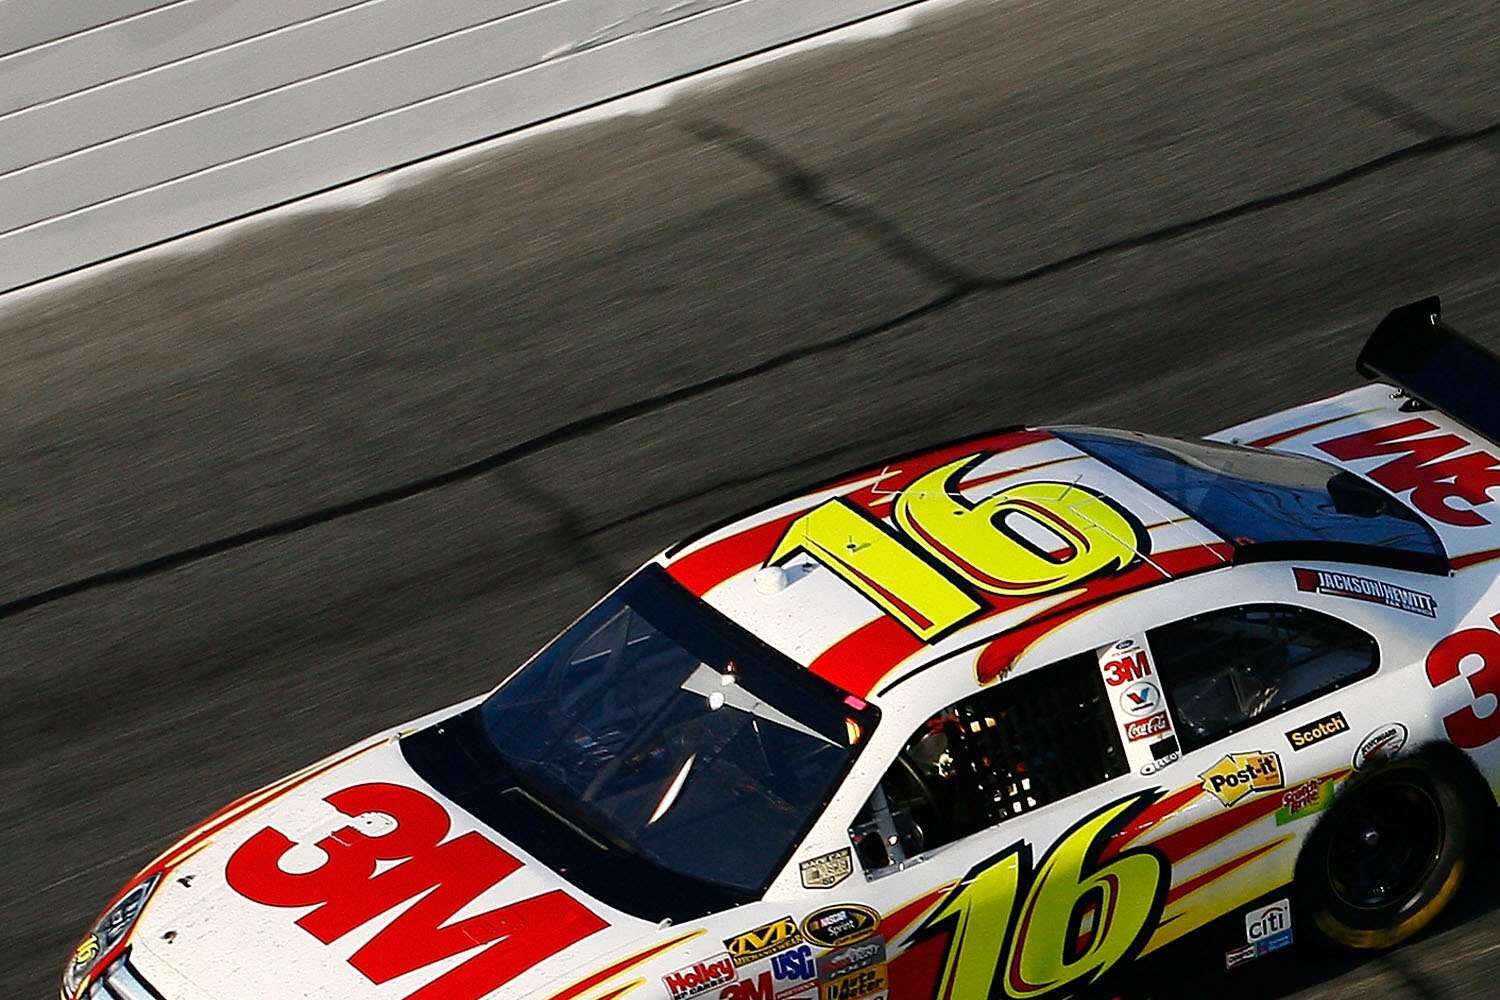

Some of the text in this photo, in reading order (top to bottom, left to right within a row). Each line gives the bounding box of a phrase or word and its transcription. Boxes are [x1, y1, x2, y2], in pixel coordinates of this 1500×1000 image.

[763, 452, 1151, 644] 16
[1318, 572, 1381, 597] JACKSON
[1104, 651, 1152, 686] 3M
[1292, 717, 1345, 746] Scotch
[1210, 754, 1276, 792] Post-it
[1249, 907, 1284, 939] citi
[666, 958, 735, 994] Holley
[771, 945, 815, 980] USG
